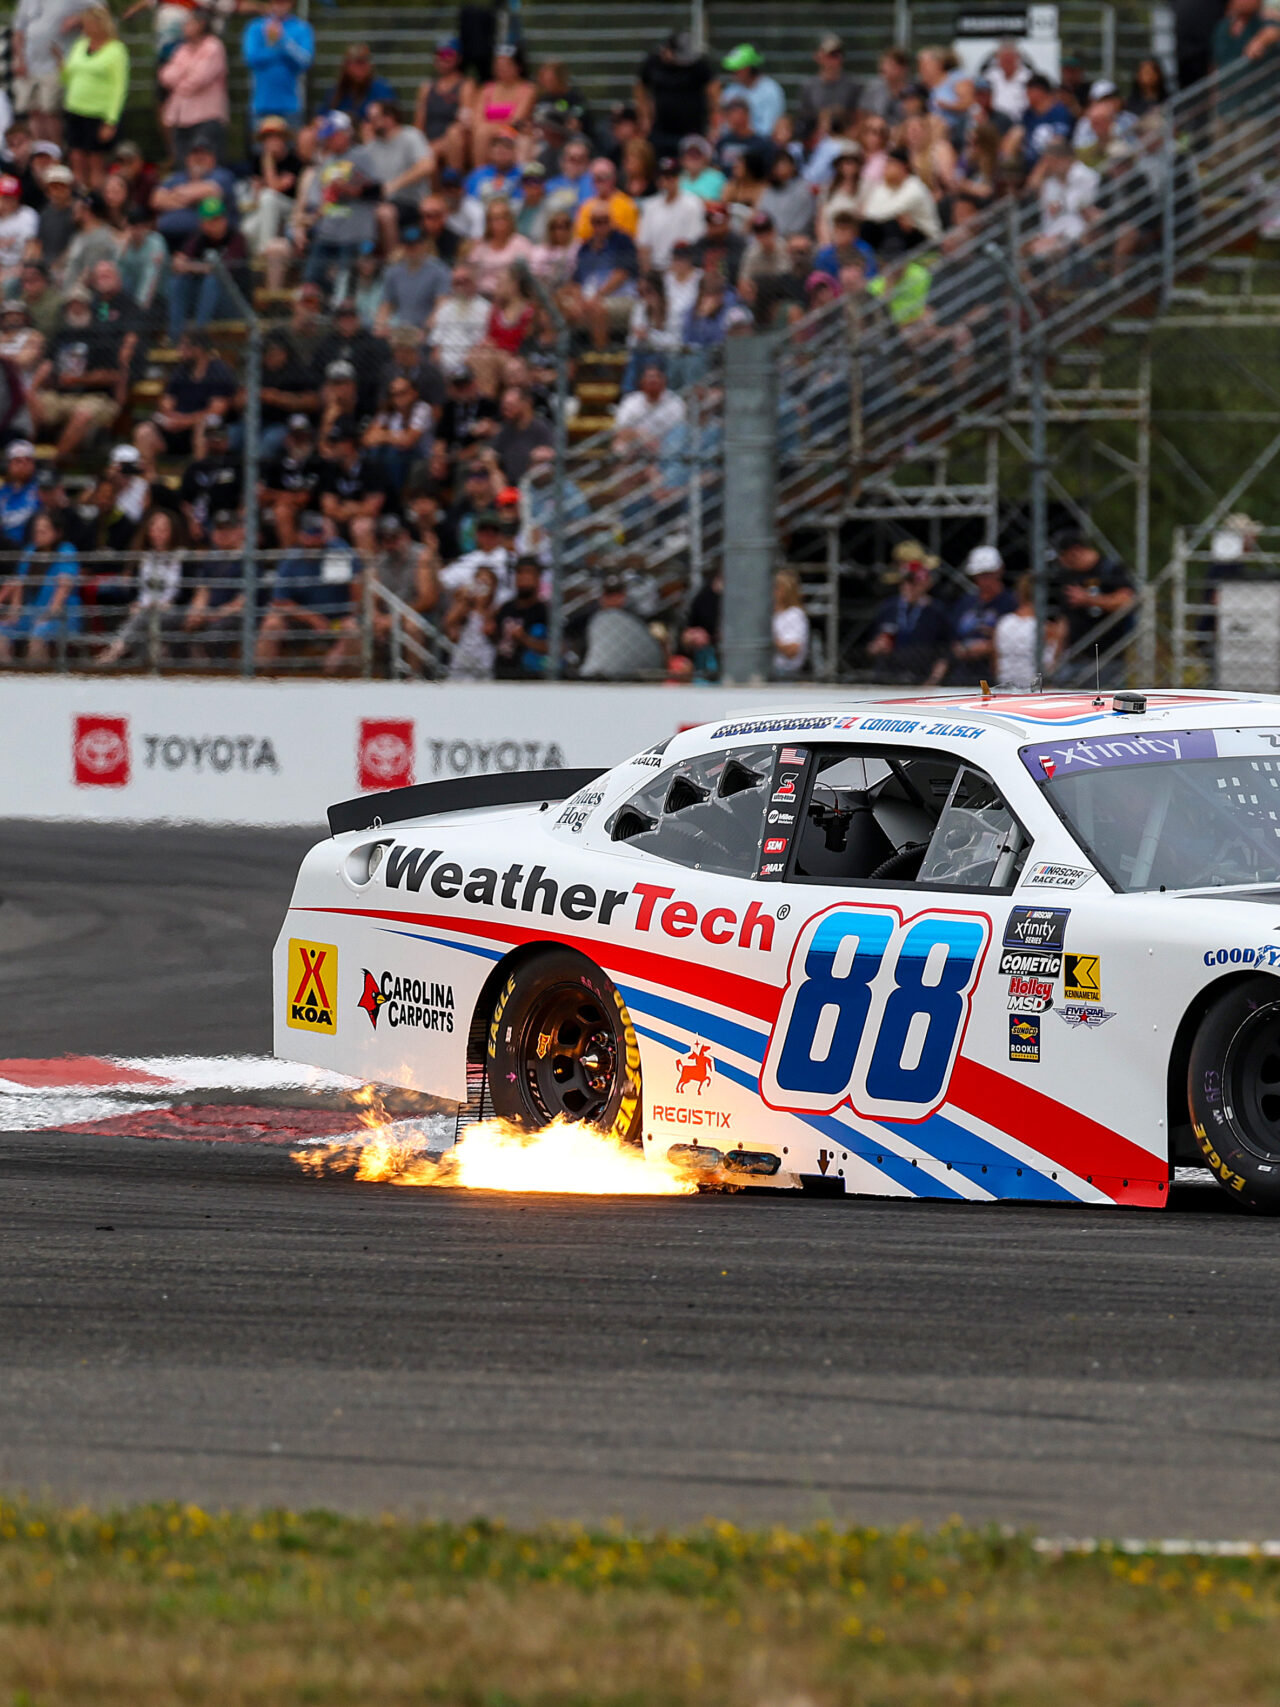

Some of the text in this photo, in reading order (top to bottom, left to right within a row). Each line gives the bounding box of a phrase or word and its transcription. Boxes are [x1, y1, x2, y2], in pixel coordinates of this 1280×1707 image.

[859, 717, 921, 734] CONNOR
[926, 722, 986, 740] ZILISCH
[143, 735, 281, 776] TOYOTA
[427, 738, 567, 774] TOYOTA
[1053, 735, 1182, 767] xfinity
[556, 806, 588, 832] Hog
[766, 841, 783, 851] SEM
[1032, 875, 1076, 886] RACE CAR
[1046, 866, 1084, 879] NASCAR
[1014, 918, 1056, 942] xfinity
[1024, 936, 1042, 945] SERIES
[1001, 954, 1061, 974] COMETIC
[380, 970, 455, 1010] CAROLINA
[1009, 976, 1053, 1001] Holley
[1064, 989, 1100, 1001] KENNAMETAL
[291, 1003, 333, 1026] KOA
[773, 908, 987, 1107] 88
[1007, 995, 1047, 1012] MSD
[1065, 1006, 1104, 1017] FIVE STAR
[388, 1001, 454, 1034] CARPORTS
[487, 973, 517, 1059] EAGLE
[1012, 1026, 1038, 1036] SUNOCO
[1010, 1044, 1039, 1054] ROOKIE
[652, 1104, 732, 1129] REGISTIX
[1193, 1122, 1247, 1192] EAGLE
